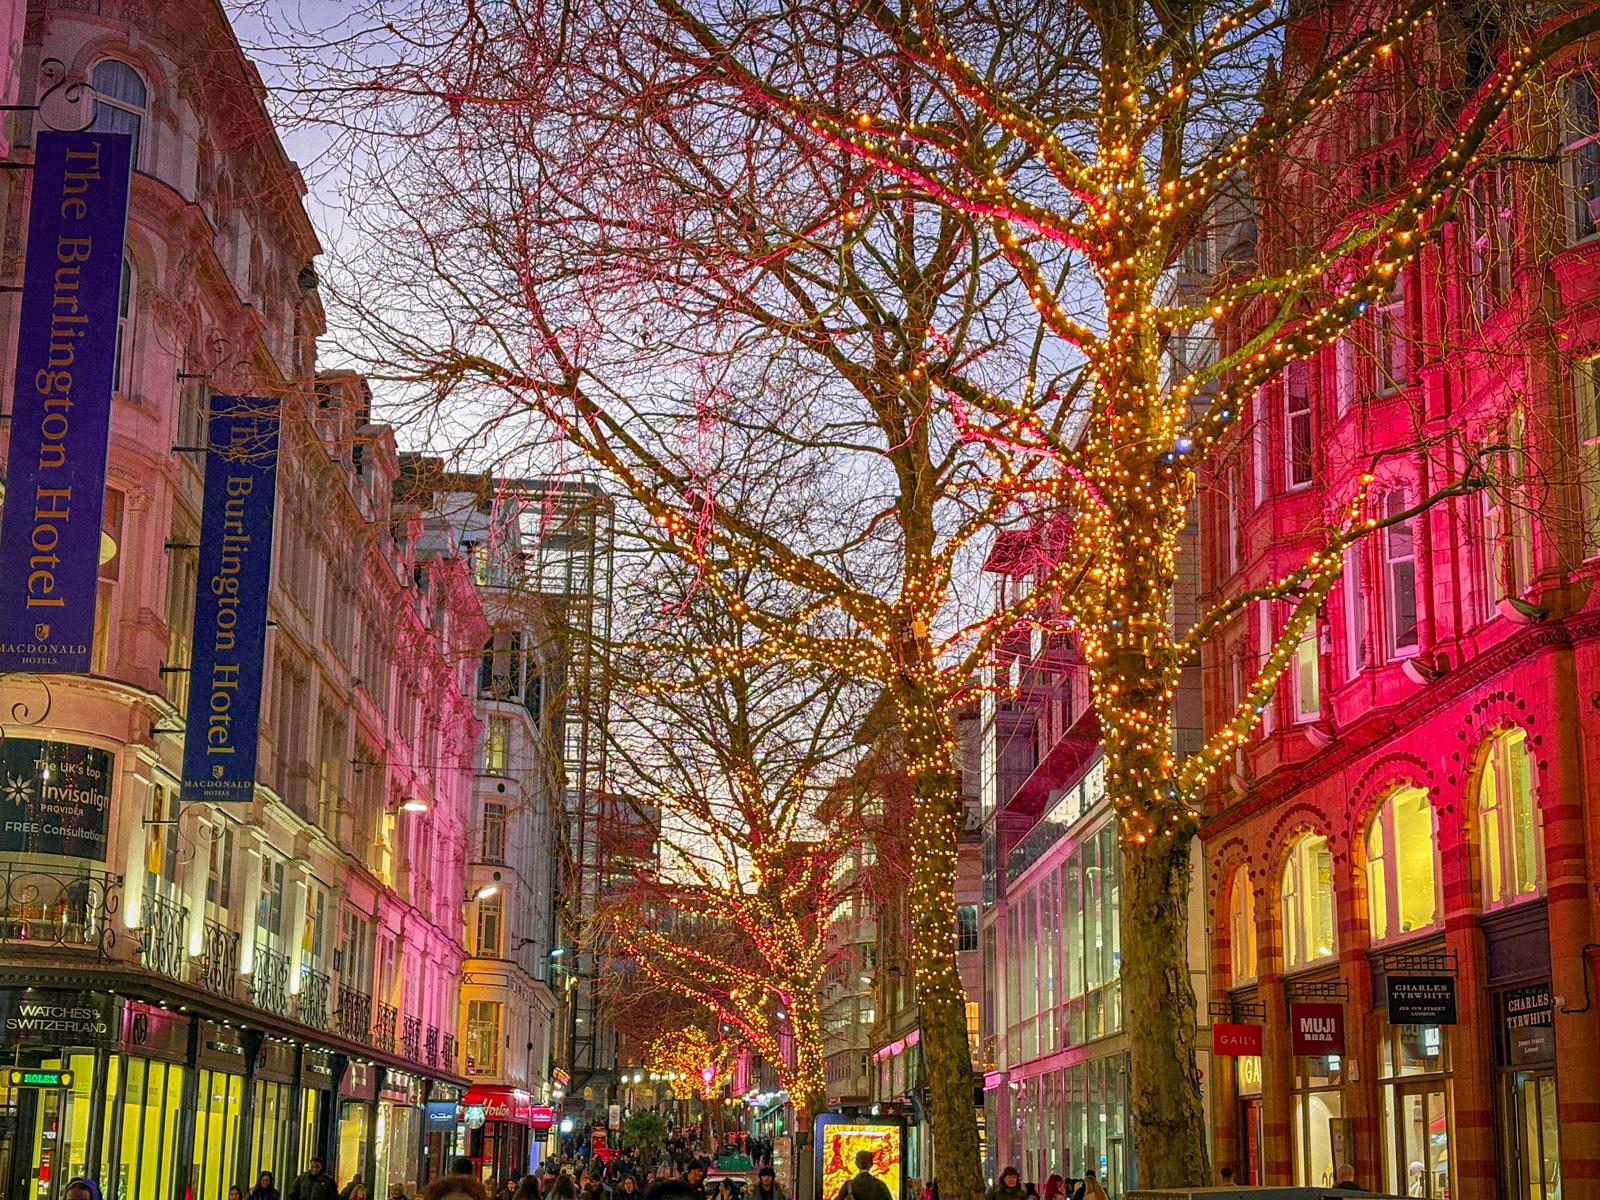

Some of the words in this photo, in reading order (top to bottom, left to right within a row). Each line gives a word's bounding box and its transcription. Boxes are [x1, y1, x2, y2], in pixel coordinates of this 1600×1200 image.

[60, 141, 102, 220] The
[35, 234, 92, 470] Burlington
[26, 485, 72, 609] Hotel
[211, 474, 253, 651] Burlington
[22, 656, 57, 665] HOTELS
[207, 663, 240, 755] Hotel
[33, 759, 56, 771] The
[60, 761, 84, 775] UK's
[86, 766, 101, 779] top
[184, 780, 251, 788] MACDONALD
[40, 803, 84, 816] PROVIDER
[5, 821, 39, 832] FREE
[1508, 993, 1549, 1012] CHARLES
[19, 1005, 91, 1019] WATCHES
[1506, 1010, 1552, 1029] TYRWHITT
[6, 1018, 107, 1033] SWITZERLAND
[1300, 1018, 1336, 1033] MUJI
[24, 1074, 58, 1084] ROLEX
